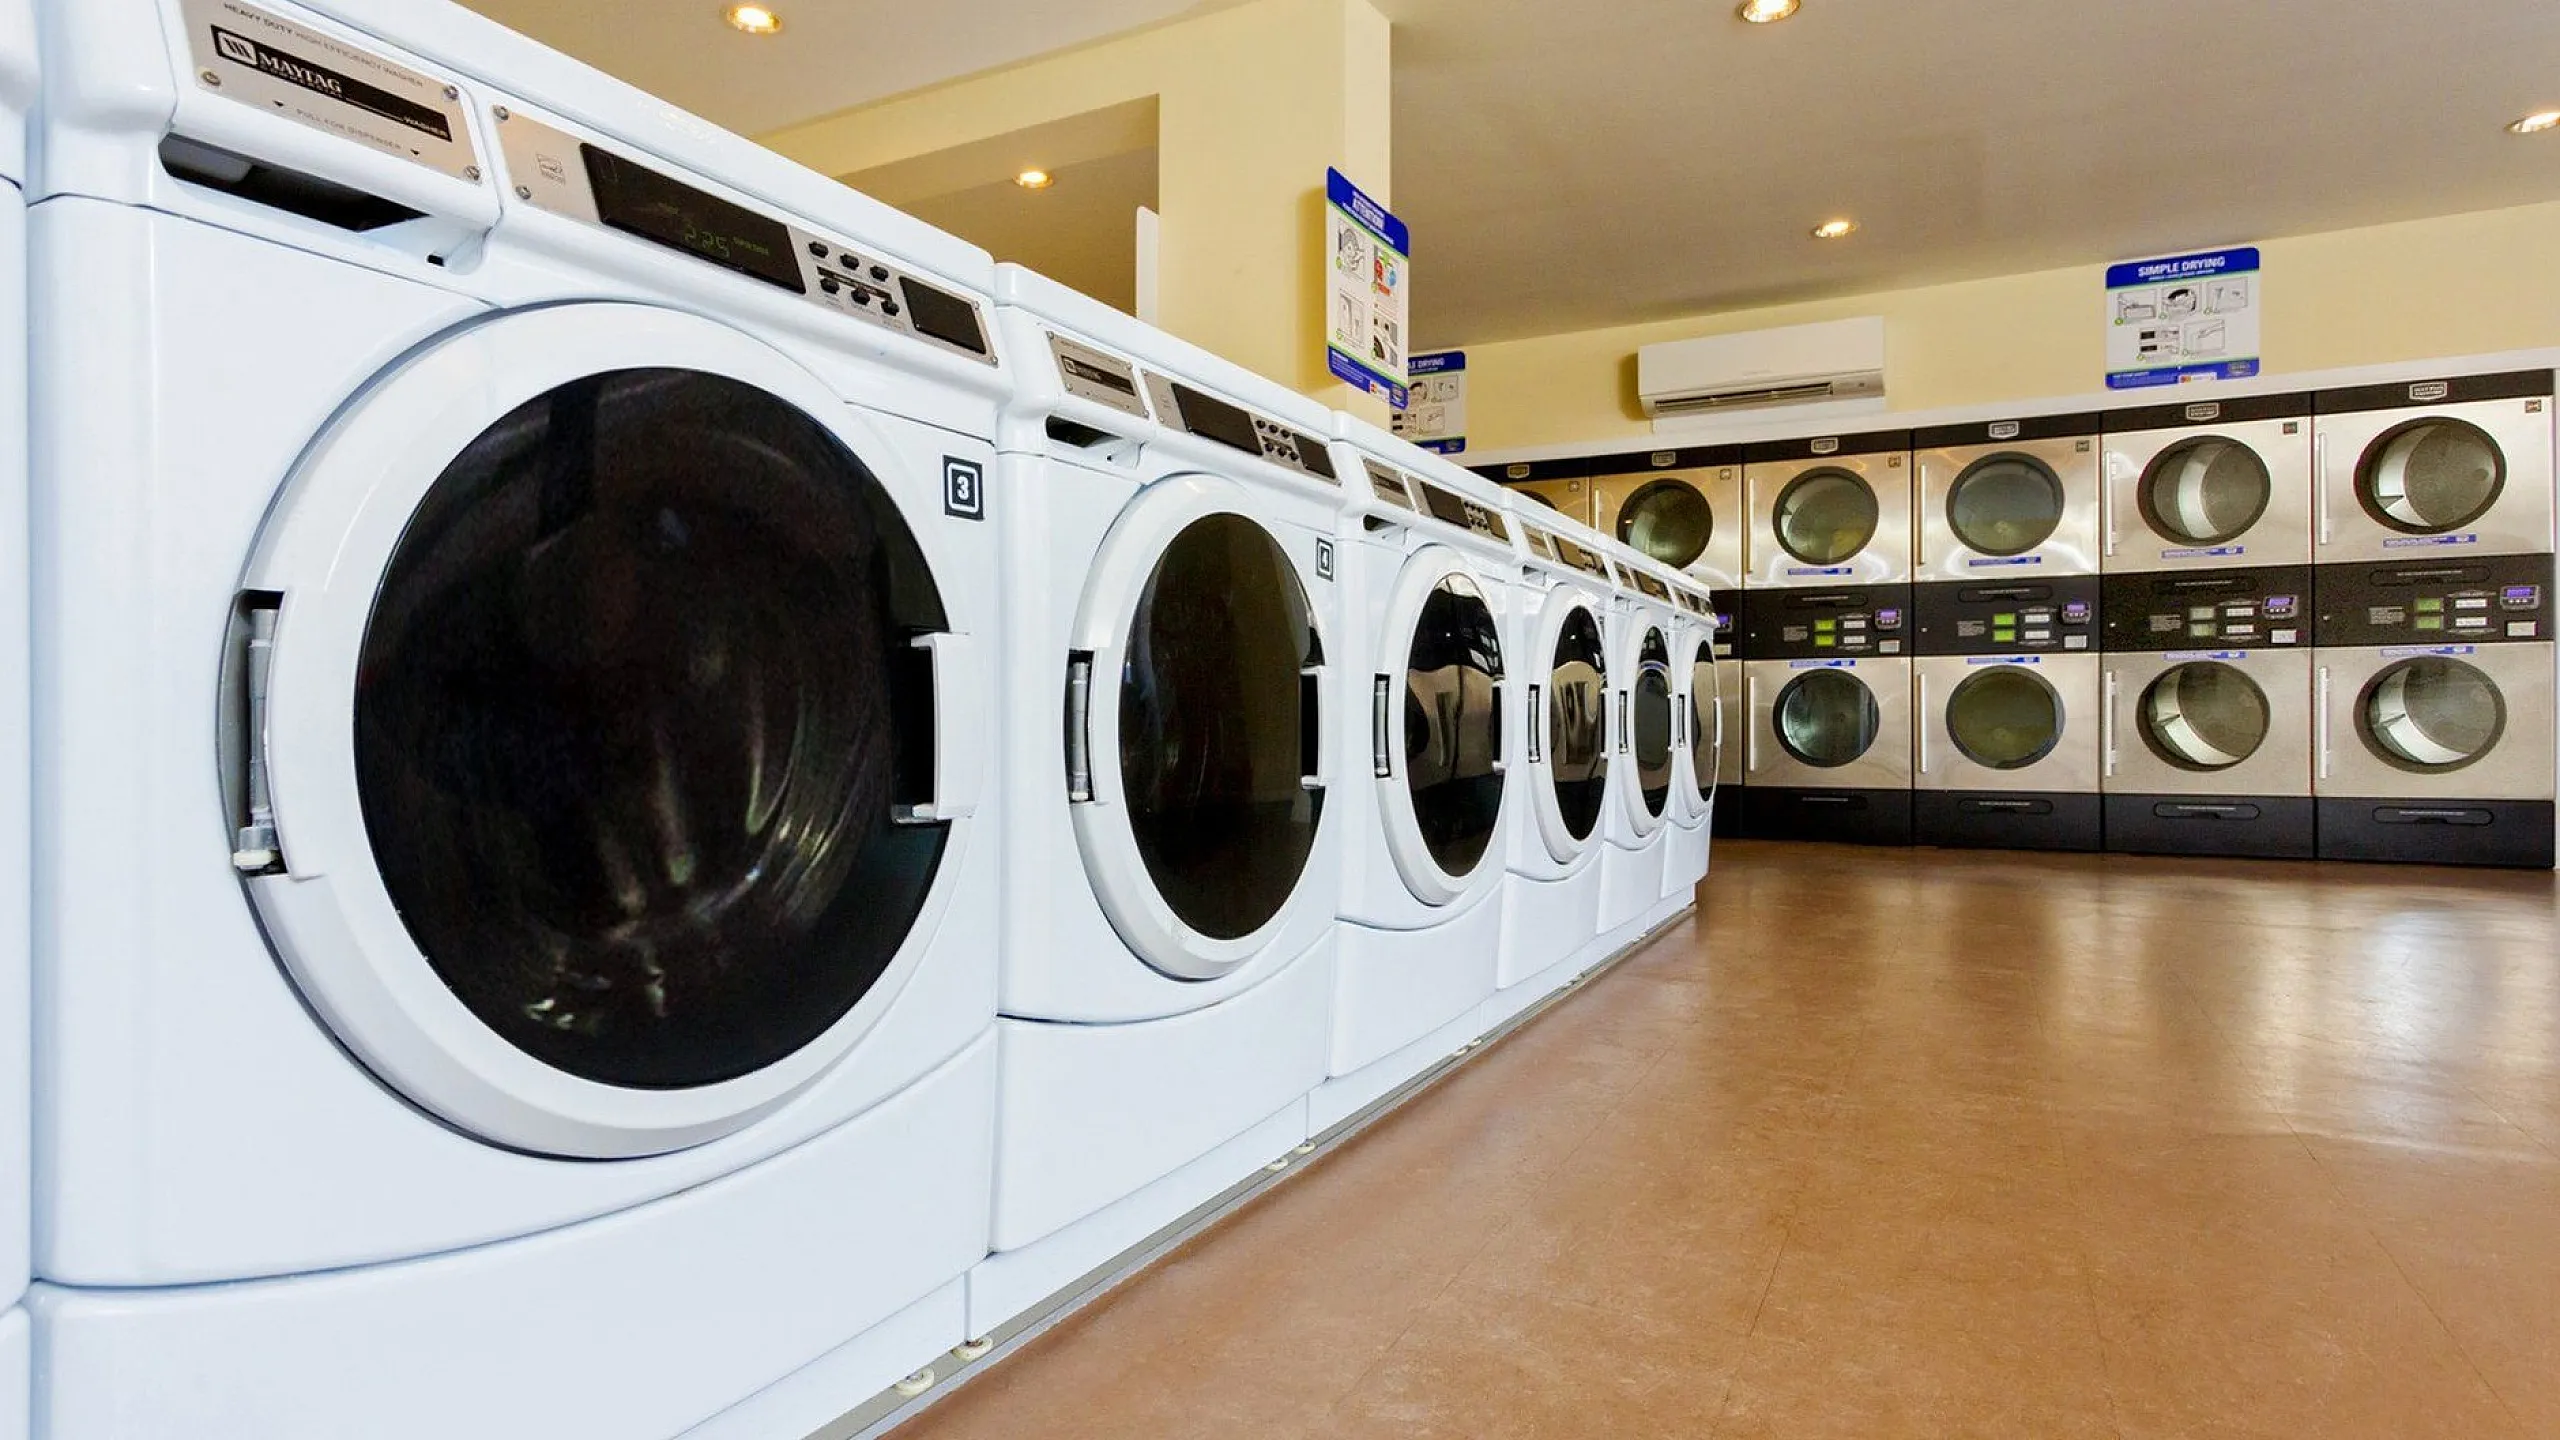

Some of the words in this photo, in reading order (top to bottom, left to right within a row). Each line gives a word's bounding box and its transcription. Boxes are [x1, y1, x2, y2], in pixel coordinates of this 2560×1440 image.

[223, 3, 260, 21] HEAVY
[263, 18, 292, 34] DUTY
[258, 51, 342, 94] MAYTAG
[2138, 261, 2180, 278] SIMPLE
[2181, 256, 2226, 272] DRYING
[956, 474, 970, 501] 3
